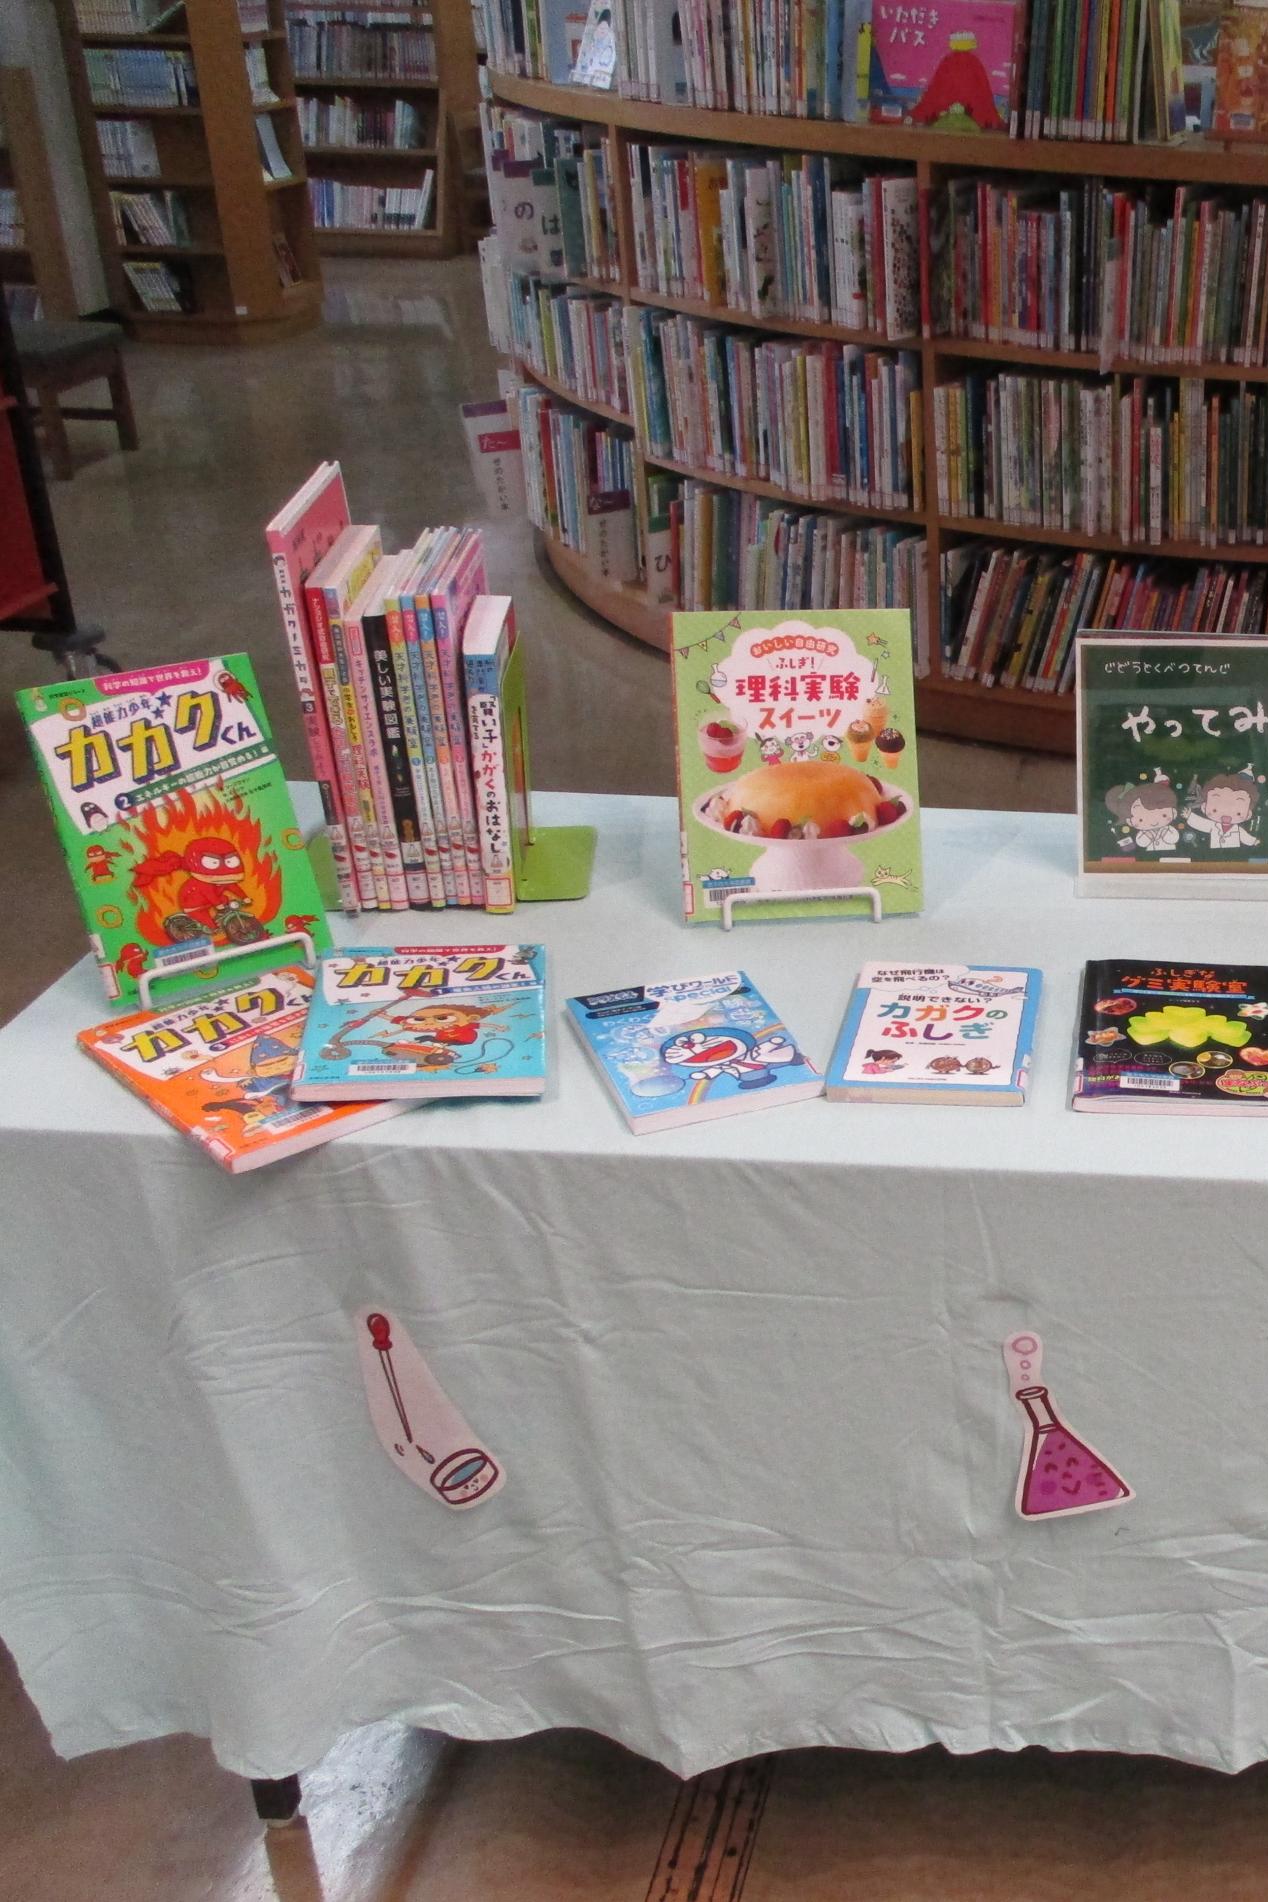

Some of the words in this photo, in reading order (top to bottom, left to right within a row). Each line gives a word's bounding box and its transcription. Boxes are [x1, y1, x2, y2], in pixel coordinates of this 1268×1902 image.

[879, 4, 940, 29] いただき
[888, 28, 926, 46] バス
[514, 201, 535, 221] の
[541, 214, 562, 235] は
[750, 635, 839, 657] おいしい自由研究
[775, 656, 816, 670] ふしぎ!
[373, 650, 401, 738] 美しい実験図鑑
[735, 671, 862, 703] 理科実験
[758, 706, 843, 729] スイーツ
[480, 750, 502, 854] かがくのおはなし
[645, 974, 740, 998] 学びワールド
[1120, 975, 1249, 994] グミ実験室
[897, 993, 993, 1004] 説明できない?
[876, 1001, 1009, 1022] カガクの
[881, 1020, 995, 1041] ふしぎ
